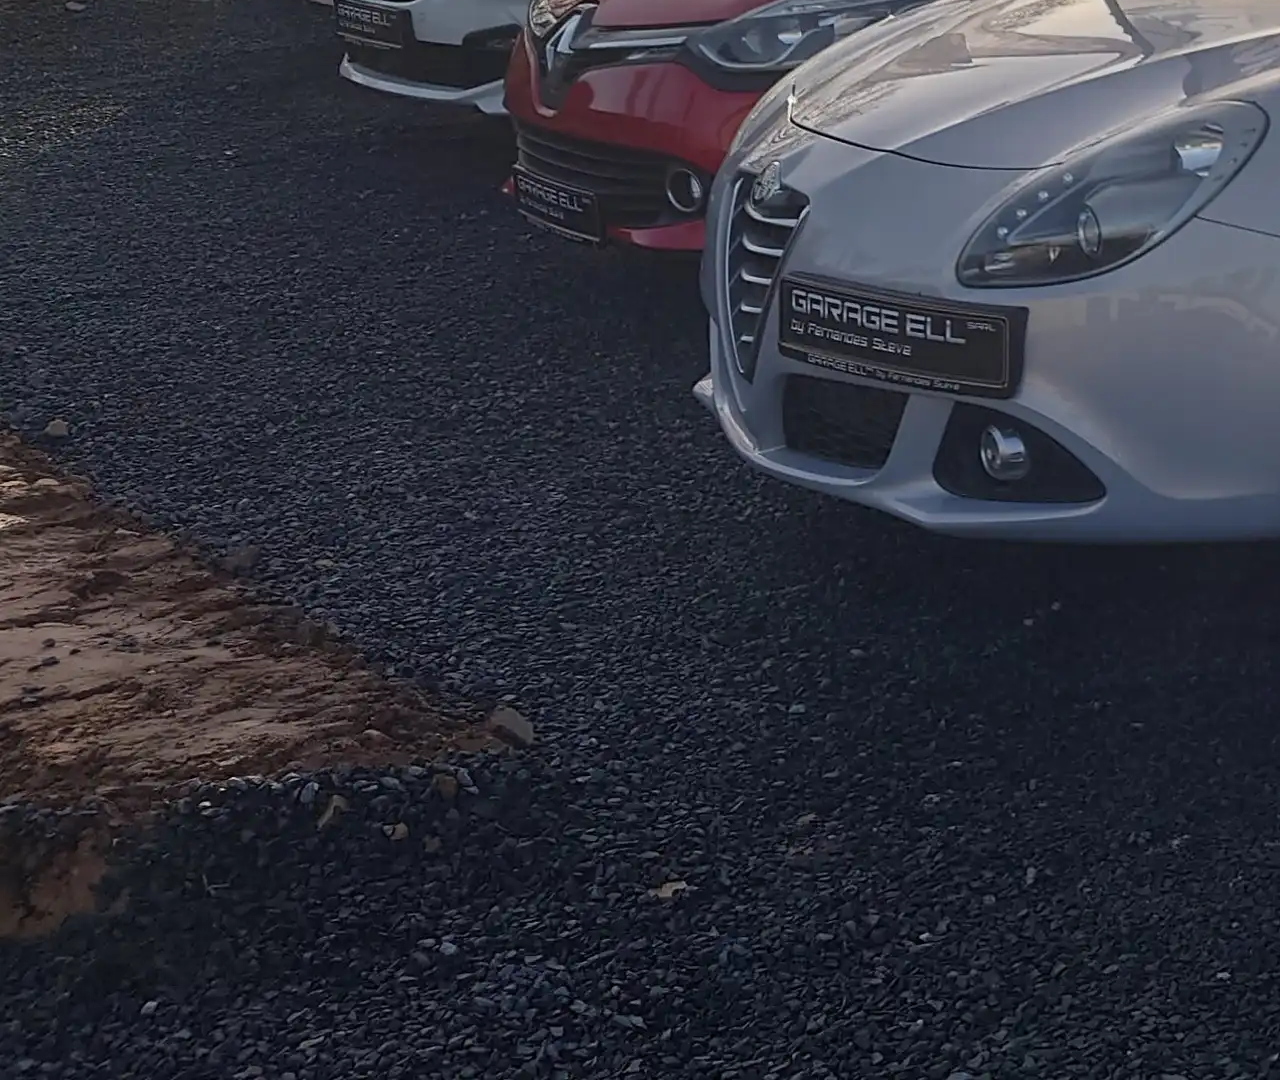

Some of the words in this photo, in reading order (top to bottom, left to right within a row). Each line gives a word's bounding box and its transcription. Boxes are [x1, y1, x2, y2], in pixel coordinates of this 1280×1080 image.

[791, 289, 900, 334] GARAGE
[905, 312, 967, 344] ELL
[791, 319, 804, 335] by
[807, 322, 868, 348] Fernandes
[871, 336, 912, 356] Steve
